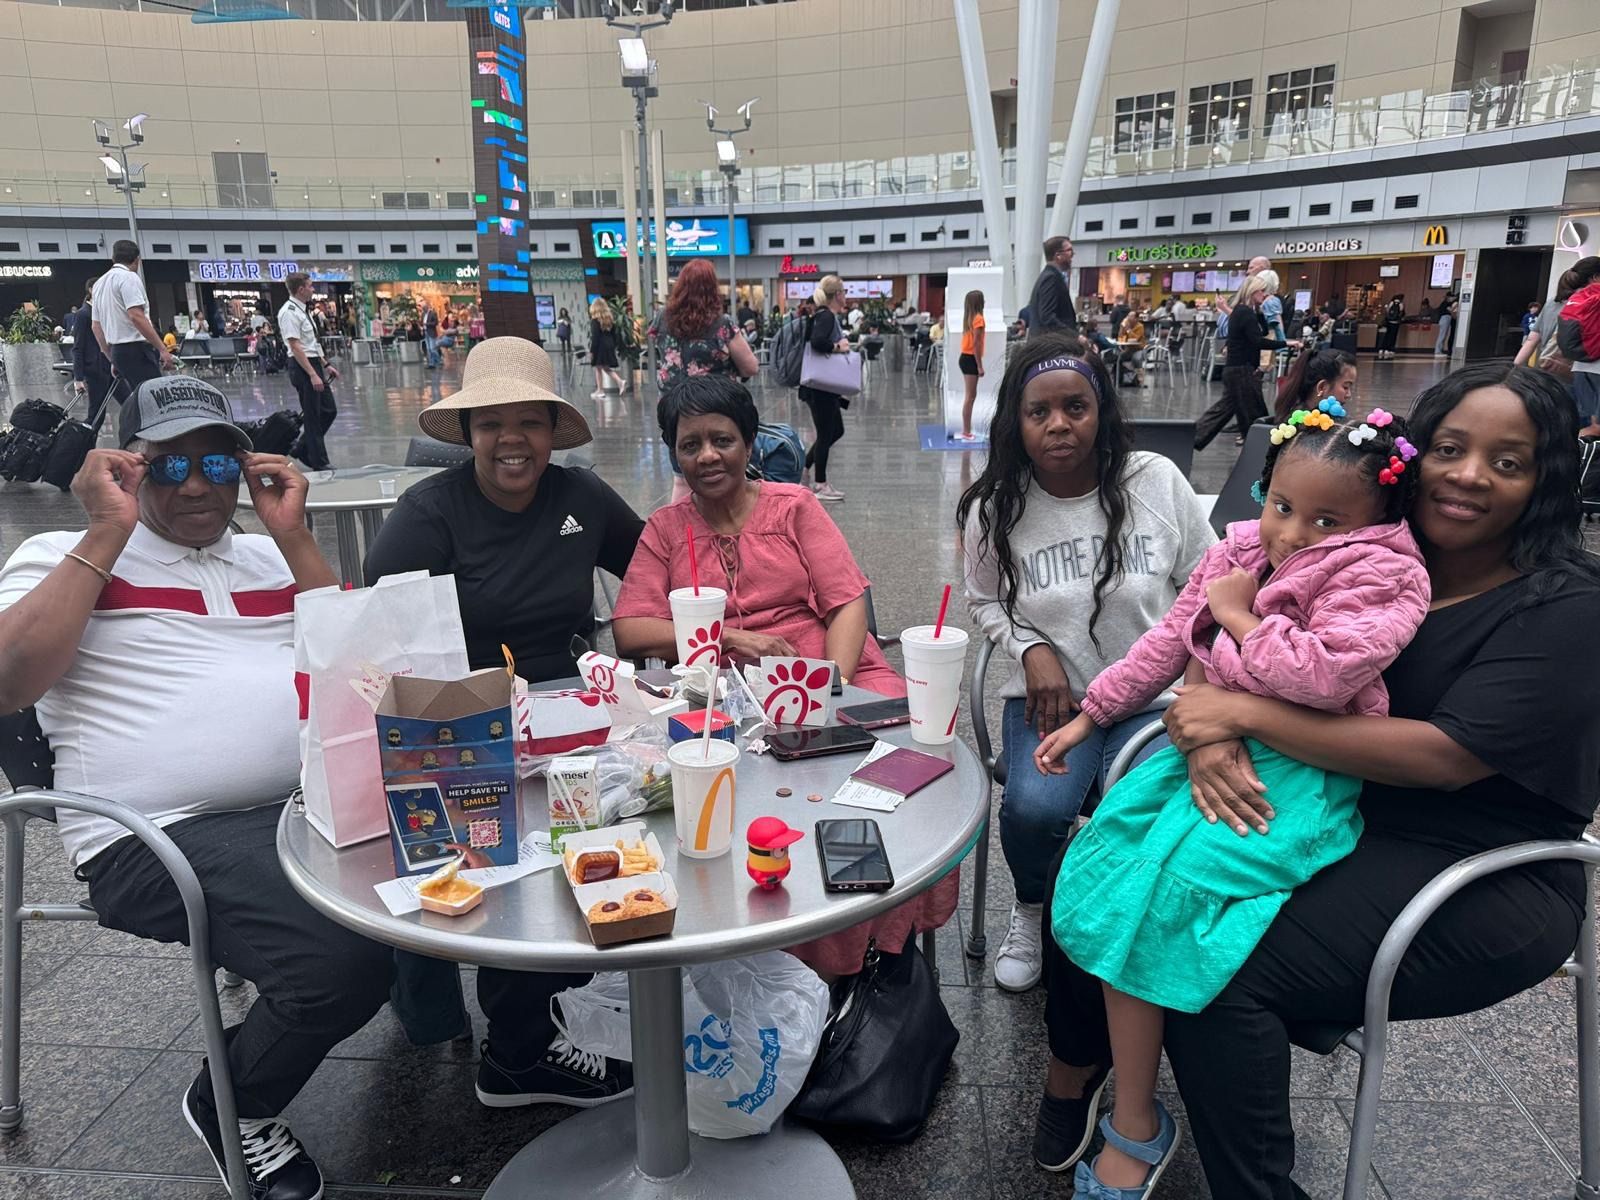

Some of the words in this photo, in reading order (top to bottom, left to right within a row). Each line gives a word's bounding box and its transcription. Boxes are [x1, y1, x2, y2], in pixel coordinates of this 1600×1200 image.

[1172, 241, 1217, 260] table
[1274, 238, 1360, 254] McDonald's
[199, 261, 261, 281] GEAR
[1038, 358, 1079, 371] LUVME
[559, 525, 584, 536] adidas
[1021, 536, 1090, 597] NOTRE
[1090, 533, 1159, 577] DME
[449, 788, 470, 796] HELP
[470, 786, 491, 794] SAVE
[463, 795, 498, 807] SMILES
